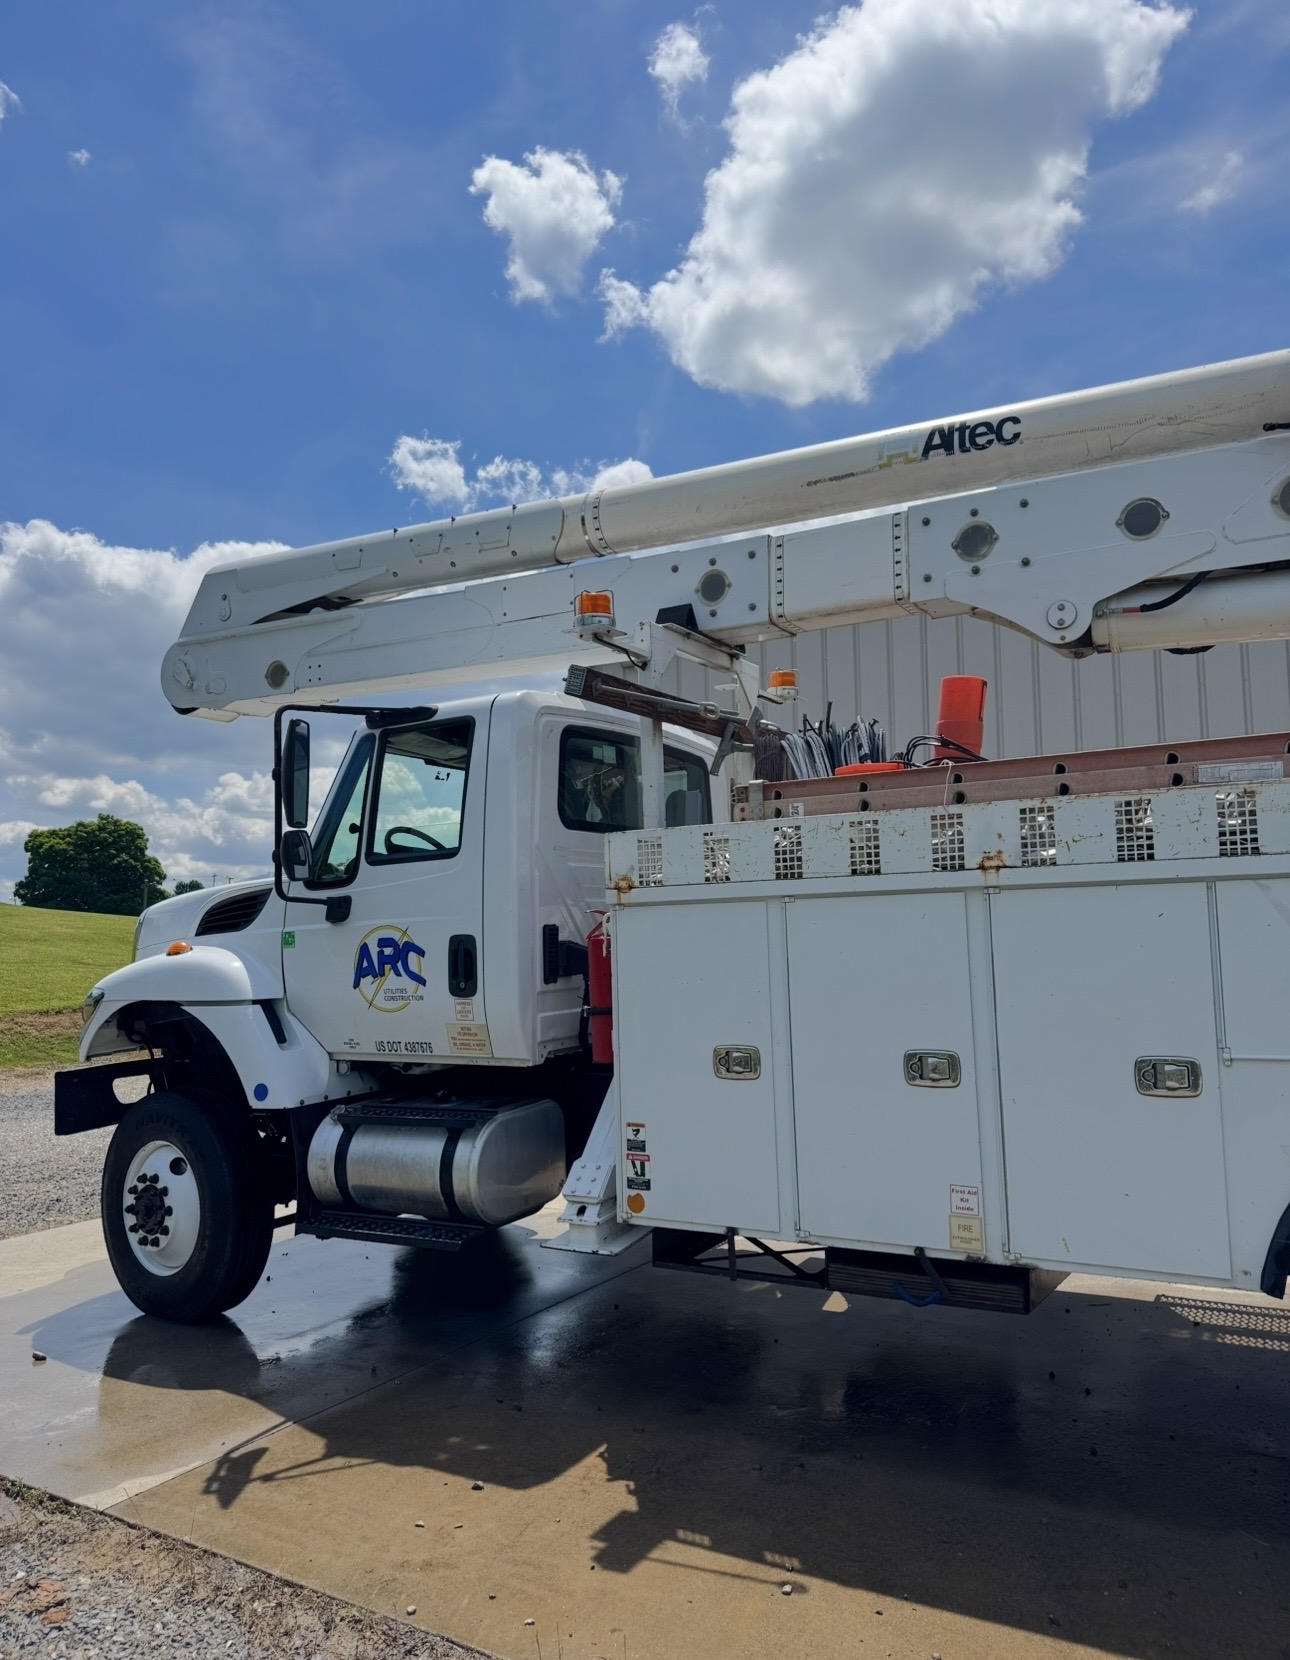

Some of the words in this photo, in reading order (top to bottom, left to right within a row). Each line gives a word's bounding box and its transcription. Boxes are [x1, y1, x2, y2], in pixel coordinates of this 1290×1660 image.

[921, 415, 1022, 460] Altec
[353, 937, 427, 990] ARC
[375, 1040, 386, 1052] US
[387, 1041, 402, 1053] DOT
[404, 1041, 434, 1054] 4387676
[957, 1224, 974, 1233] FIRE
